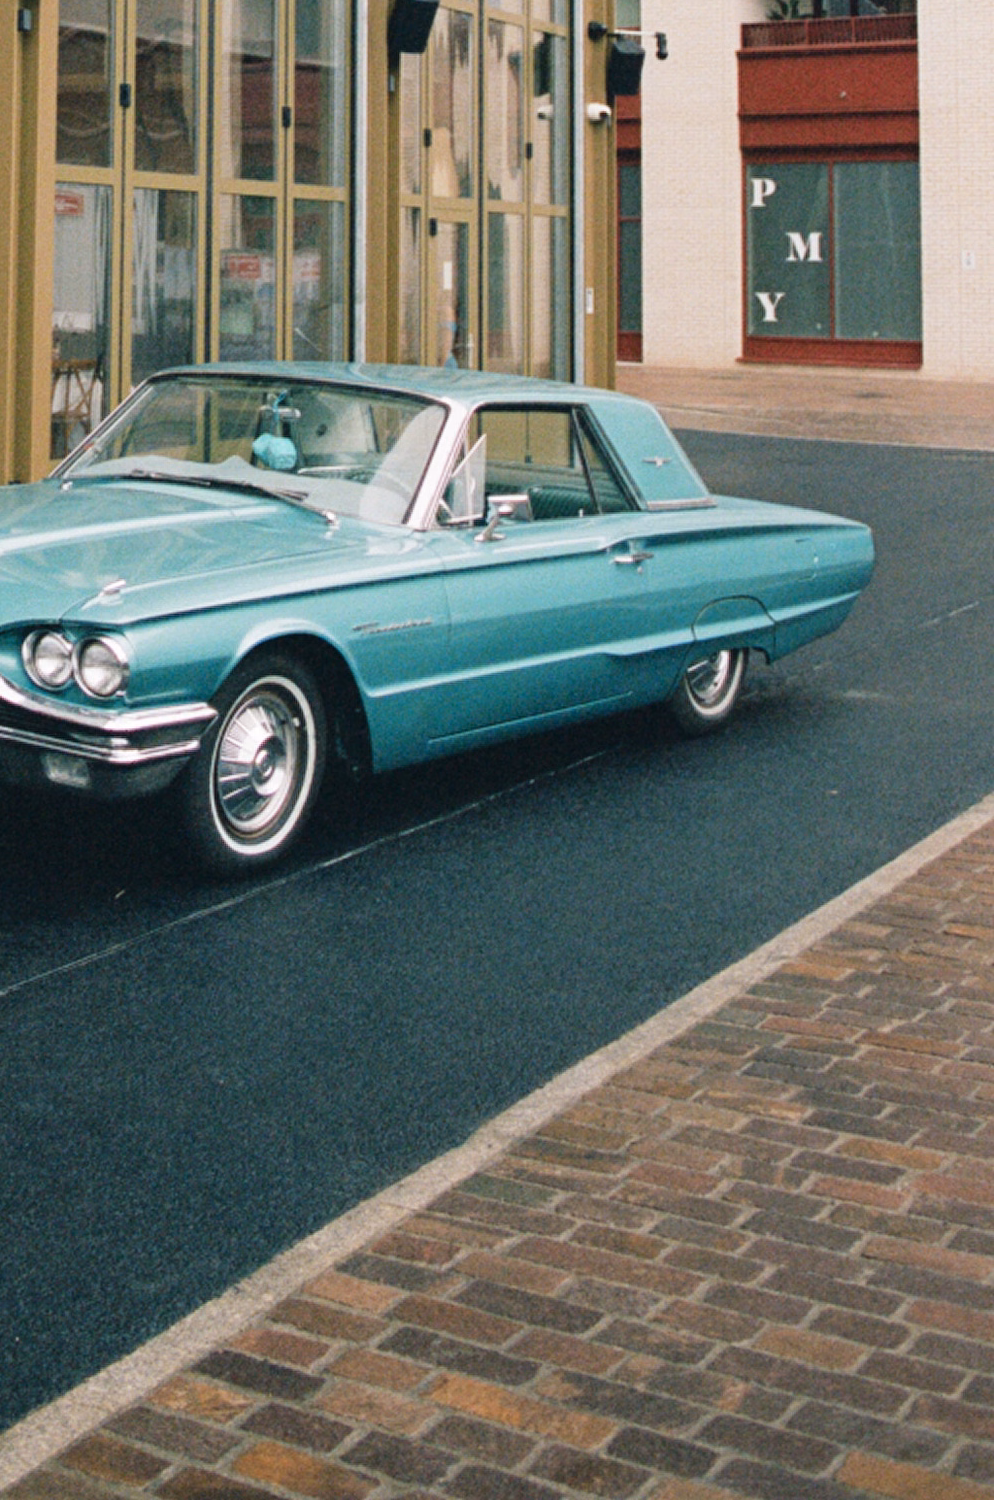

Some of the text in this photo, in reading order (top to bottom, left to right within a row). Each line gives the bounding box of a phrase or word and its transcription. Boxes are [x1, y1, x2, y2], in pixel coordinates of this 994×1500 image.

[751, 178, 776, 207] P
[786, 232, 822, 262] M
[755, 292, 785, 322] Y
